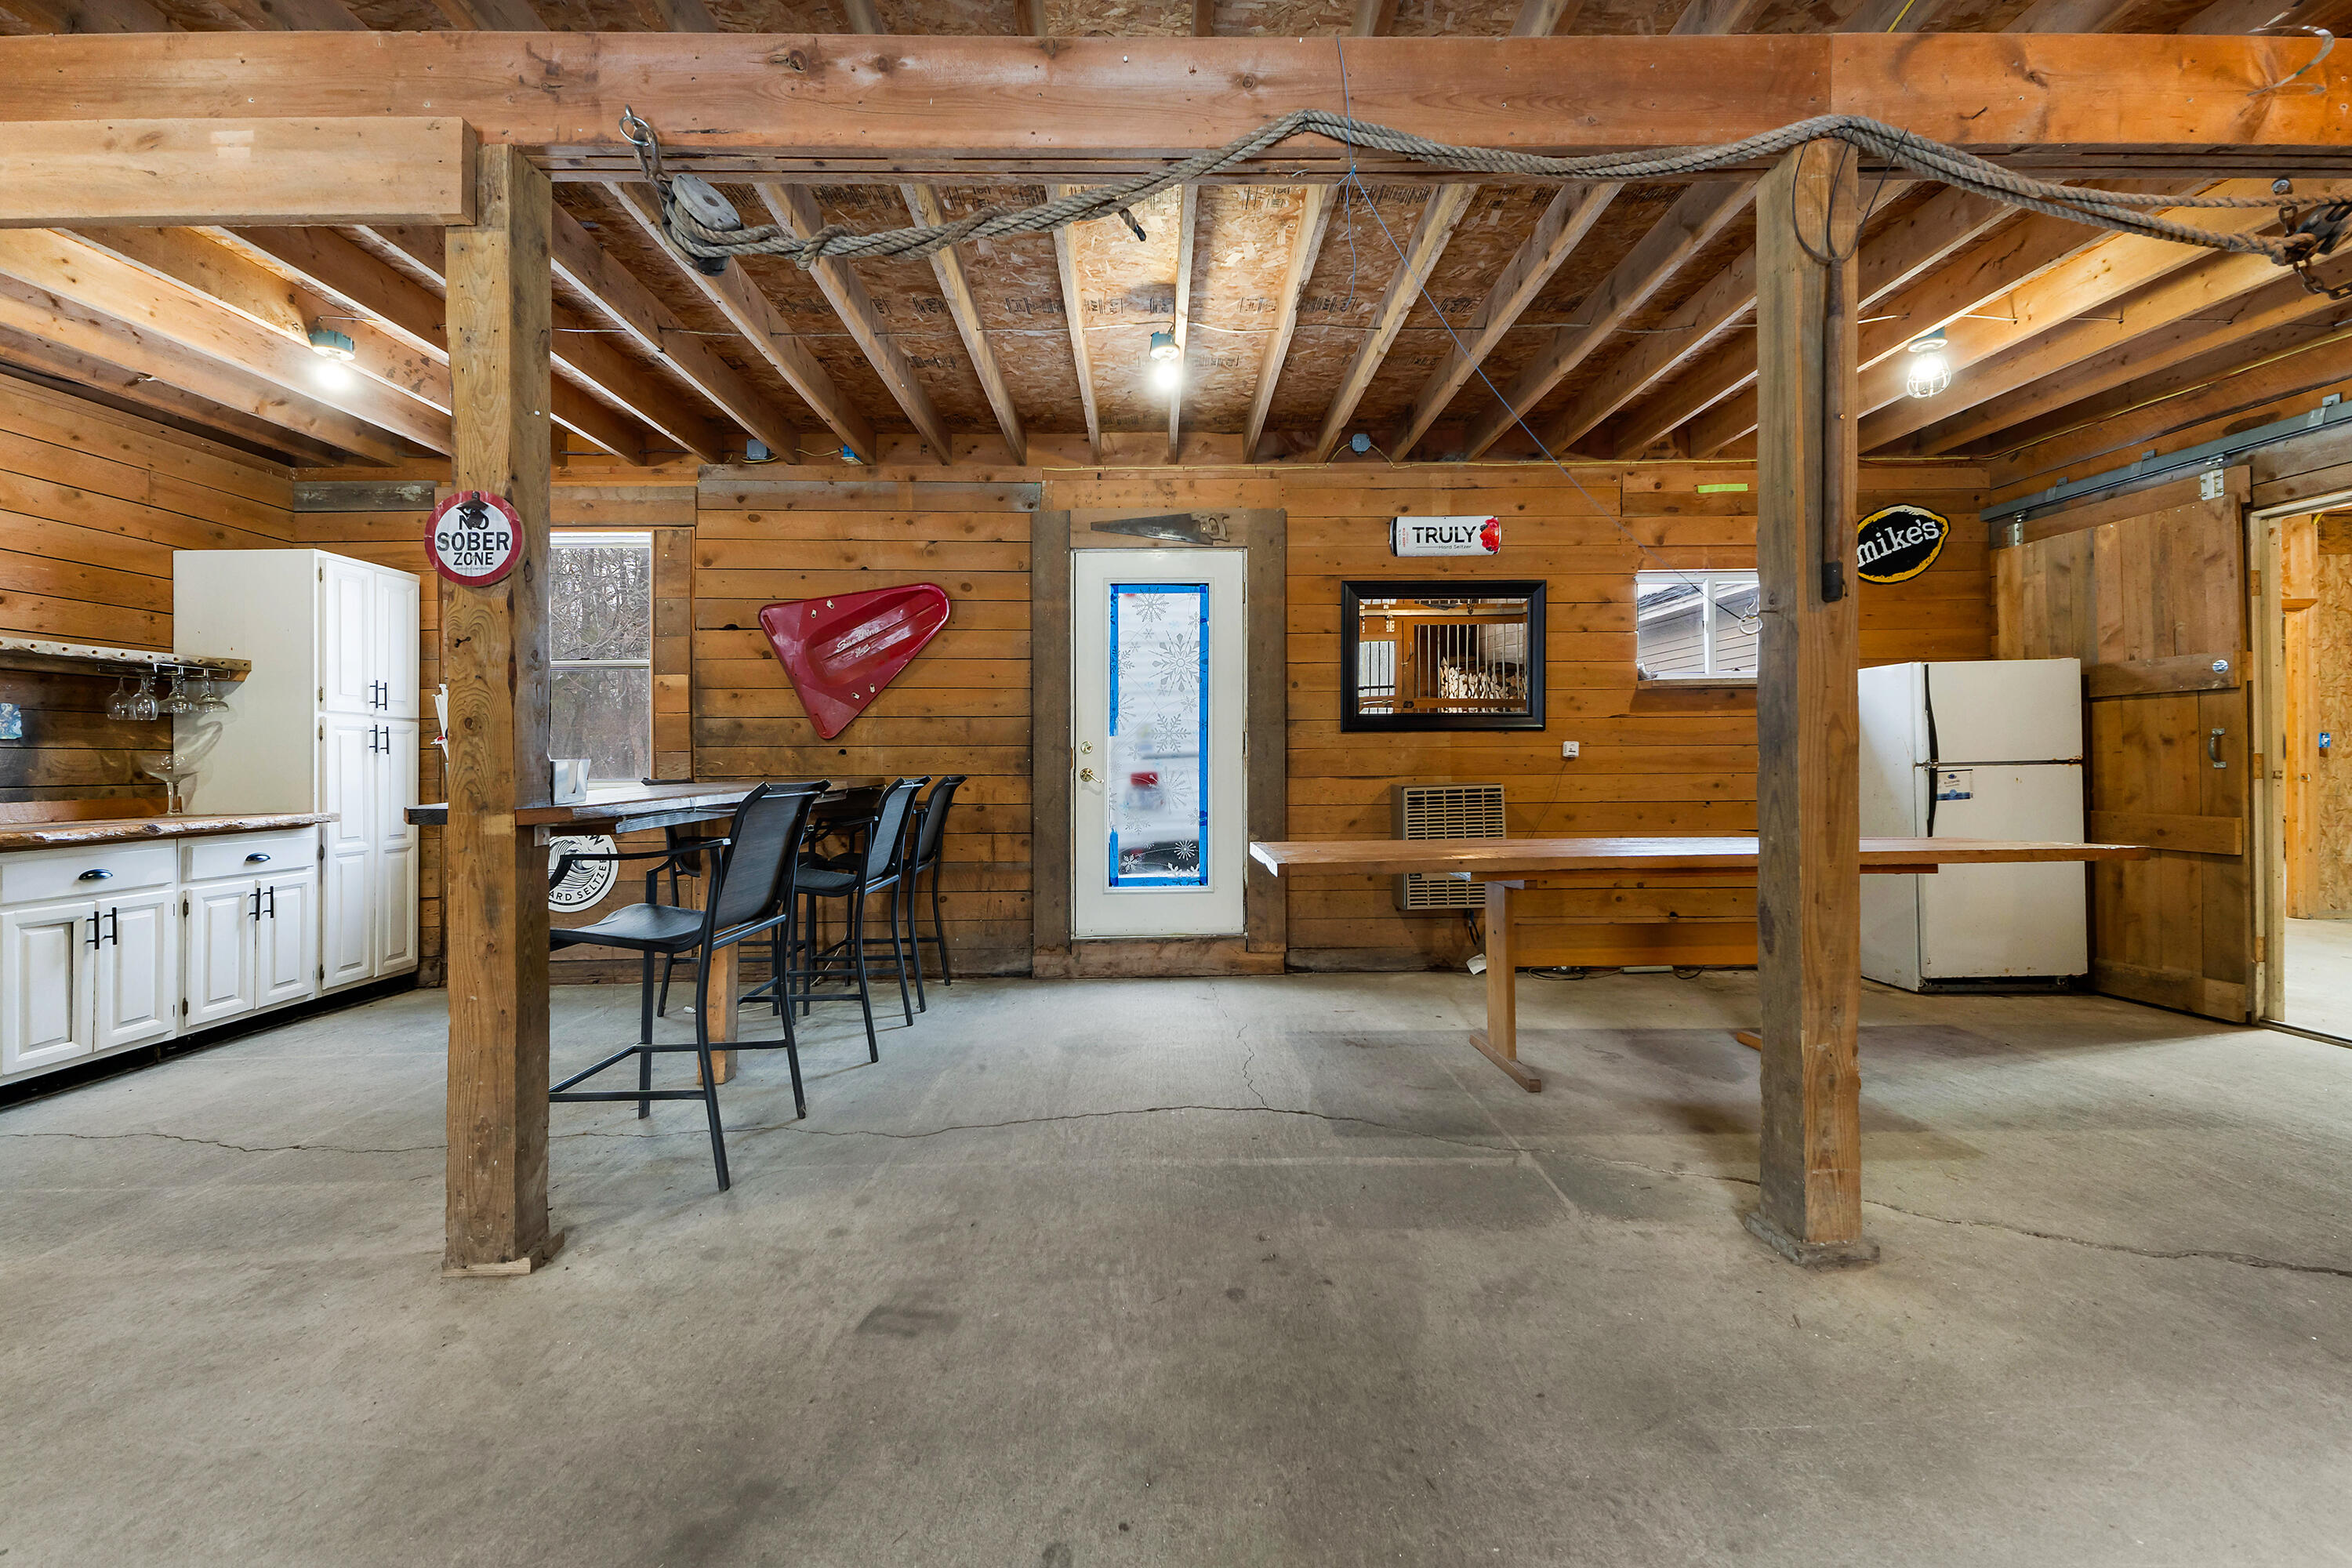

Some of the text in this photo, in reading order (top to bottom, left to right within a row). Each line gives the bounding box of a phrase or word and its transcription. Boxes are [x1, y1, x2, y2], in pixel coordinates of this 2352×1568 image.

[459, 514, 490, 530] NO
[437, 532, 510, 551] SOBER
[1412, 526, 1477, 543] TRULY
[1857, 519, 1940, 568] mike's
[453, 552, 494, 565] ZONE
[550, 891, 572, 901] ARD
